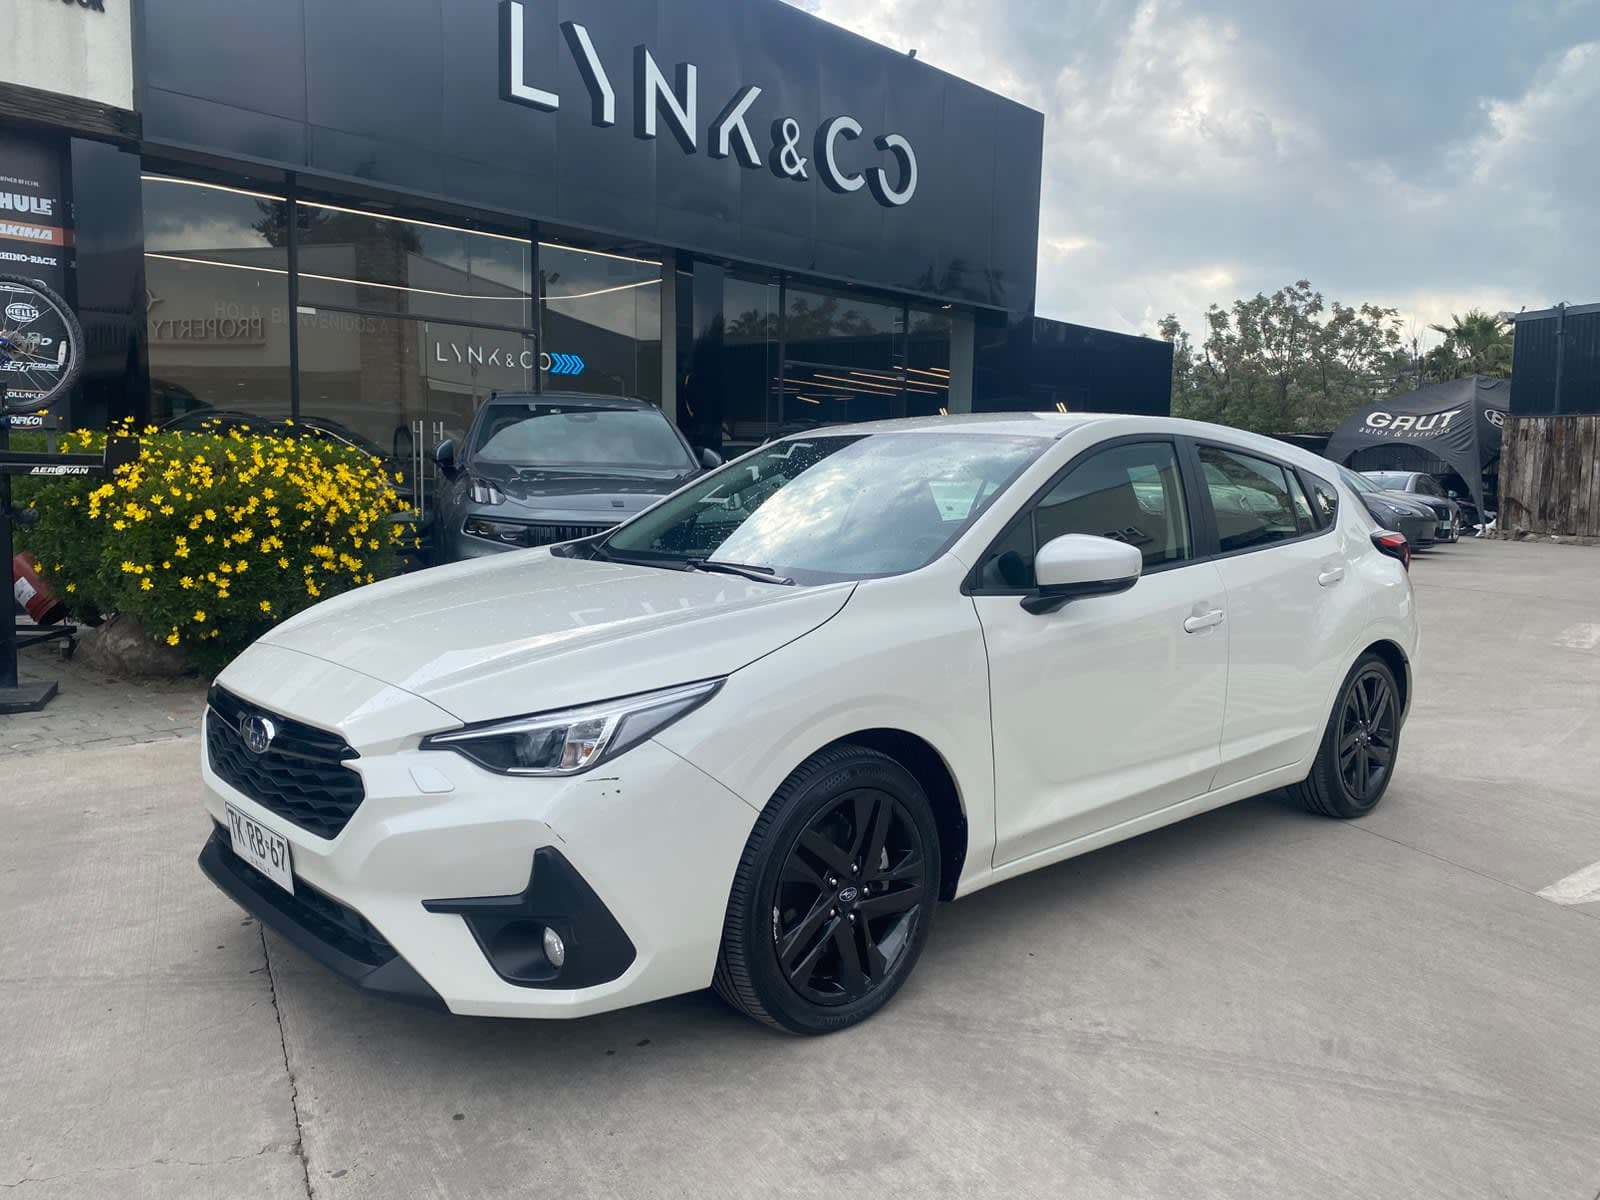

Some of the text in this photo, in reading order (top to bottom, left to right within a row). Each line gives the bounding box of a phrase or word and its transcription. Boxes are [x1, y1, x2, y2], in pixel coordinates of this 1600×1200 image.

[0, 192, 53, 216] HULE
[0, 223, 53, 240] AKIMA
[1365, 409, 1462, 431] GAUT
[1358, 427, 1389, 437] autos
[1394, 429, 1402, 438] &
[29, 465, 89, 476] AEROVAN
